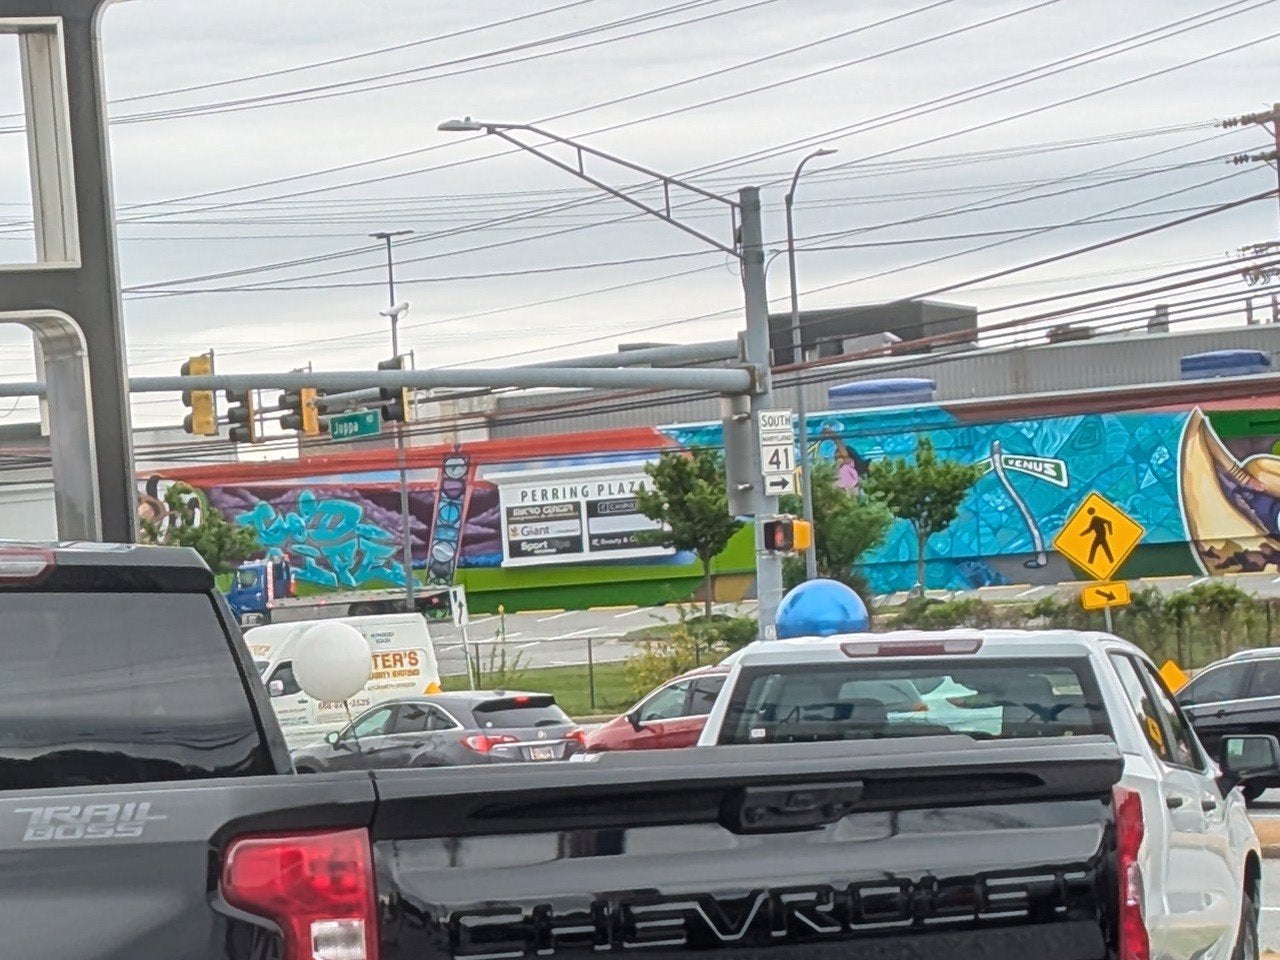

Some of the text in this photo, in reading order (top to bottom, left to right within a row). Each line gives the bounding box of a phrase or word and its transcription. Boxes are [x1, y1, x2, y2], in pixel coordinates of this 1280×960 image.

[333, 421, 359, 436] Joppa
[761, 414, 791, 427] SOUTH
[768, 447, 790, 470] 41
[1007, 459, 1058, 477] VENUS
[520, 485, 589, 502] PERRING
[14, 802, 168, 826] TRAIL
[23, 822, 146, 842] BOSS
